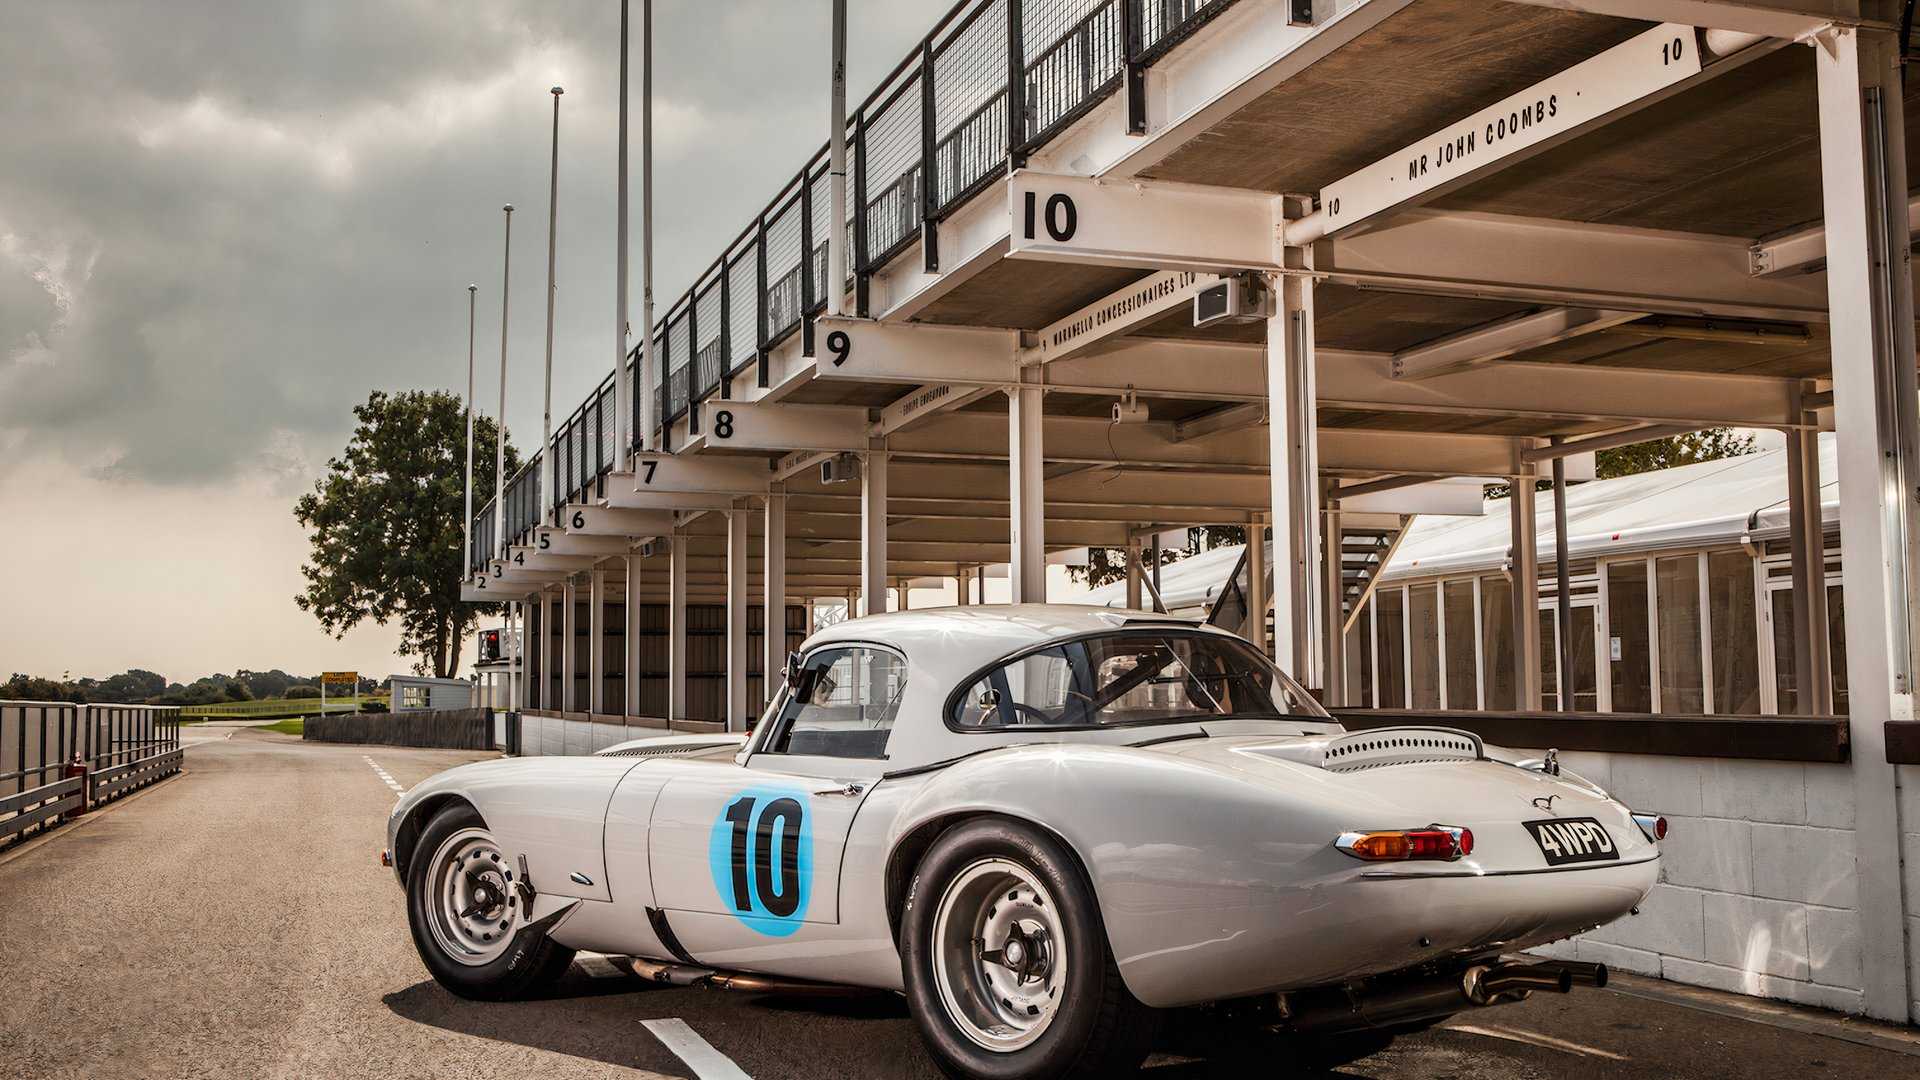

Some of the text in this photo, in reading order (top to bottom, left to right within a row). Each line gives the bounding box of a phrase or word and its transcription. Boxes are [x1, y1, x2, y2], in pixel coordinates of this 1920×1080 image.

[1662, 38, 1683, 66] 10
[1409, 94, 1557, 180] MR JOHN COOMBS
[1024, 191, 1078, 242] 10
[1328, 197, 1340, 217] 10
[1054, 315, 1093, 347] MARANELLO
[1097, 278, 1175, 326] CONCESSIONAIRES
[826, 330, 851, 368] 9
[715, 410, 734, 439] 8
[642, 460, 658, 485] 7
[572, 510, 585, 530] 6
[540, 532, 551, 550] 5
[493, 564, 503, 579] 3
[514, 550, 525, 567] 4
[477, 576, 487, 589] 2
[1535, 820, 1612, 858] 4WPD
[726, 797, 803, 917] 10
